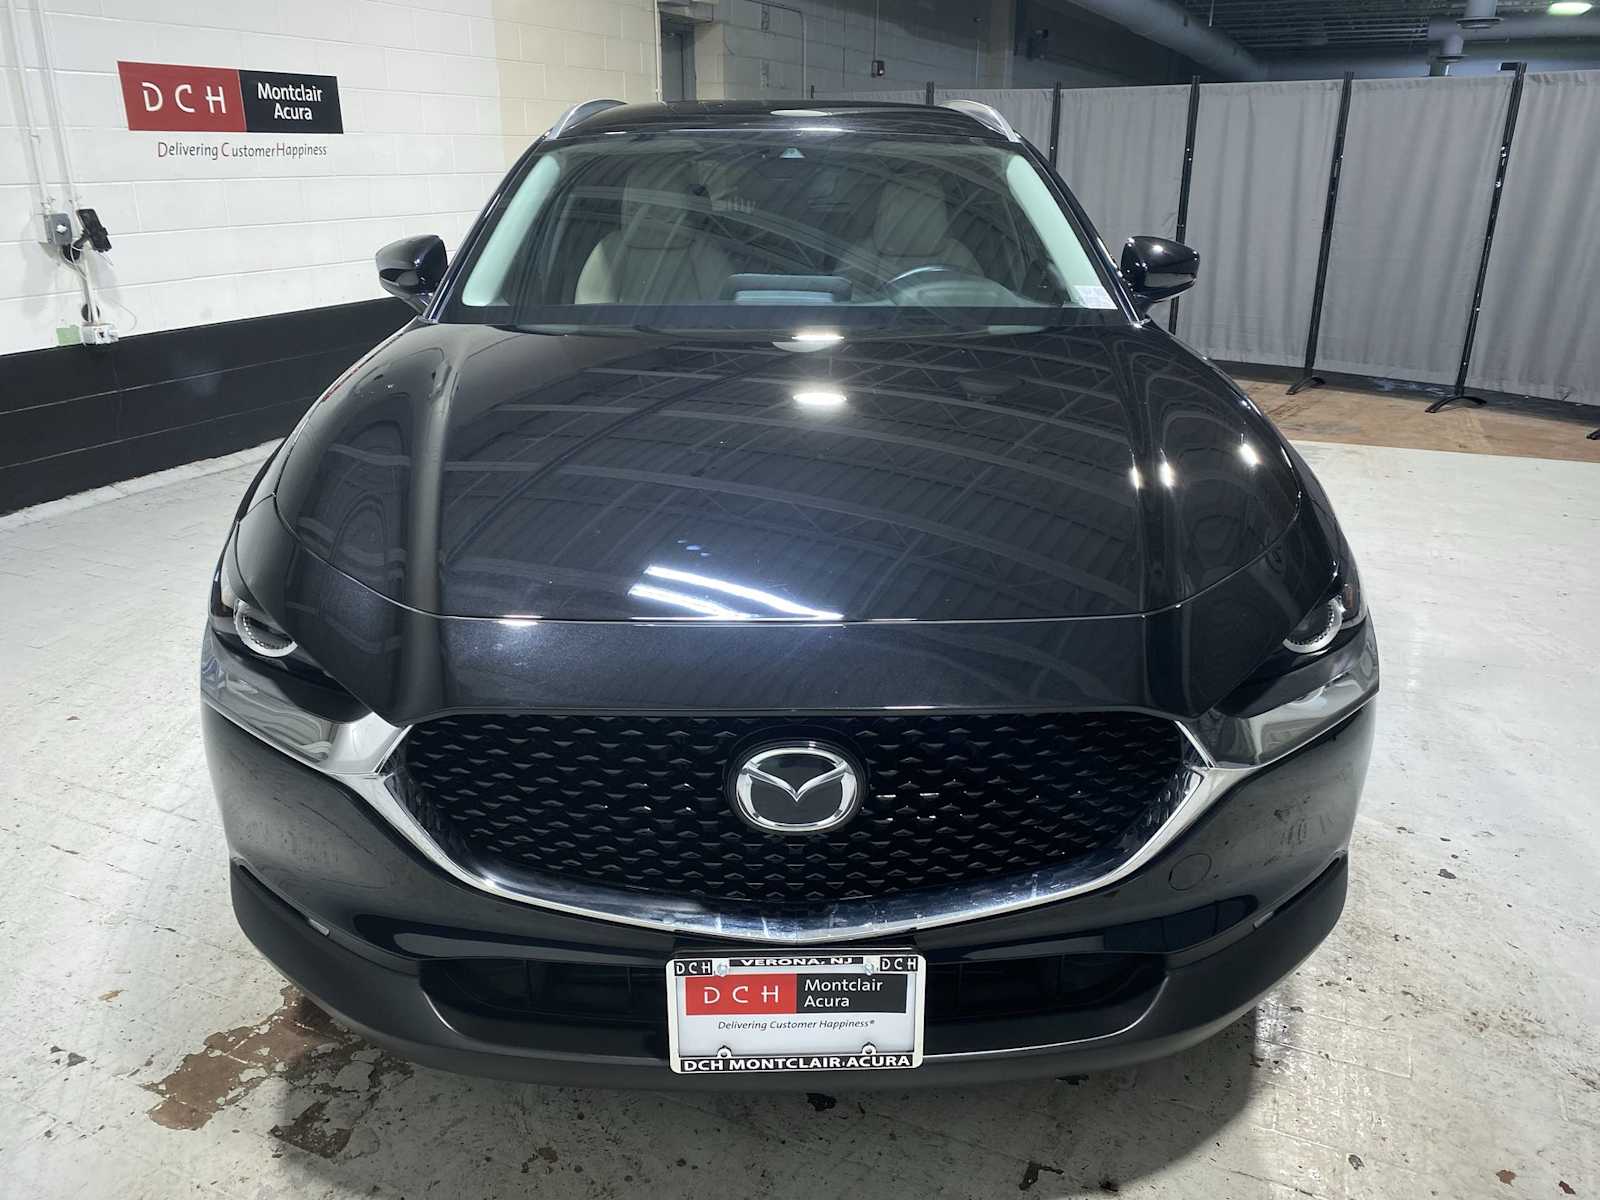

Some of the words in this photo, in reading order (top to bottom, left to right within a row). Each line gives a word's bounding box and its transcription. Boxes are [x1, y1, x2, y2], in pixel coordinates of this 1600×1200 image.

[141, 81, 227, 114] DCH
[257, 82, 322, 102] Montclair
[274, 103, 312, 121] Acura
[157, 141, 218, 160] Delivering
[674, 961, 712, 974] DCH
[830, 957, 853, 965] NJ
[881, 958, 918, 971] DCH
[804, 979, 883, 992] Montclair
[703, 985, 779, 1004] DCH
[804, 995, 850, 1008] Acura
[718, 1021, 767, 1031] Delivering
[770, 1020, 817, 1029] Customer
[683, 1060, 724, 1072] DCH
[729, 1057, 843, 1070] MONTCLAIR
[844, 1055, 911, 1068] ACURA
